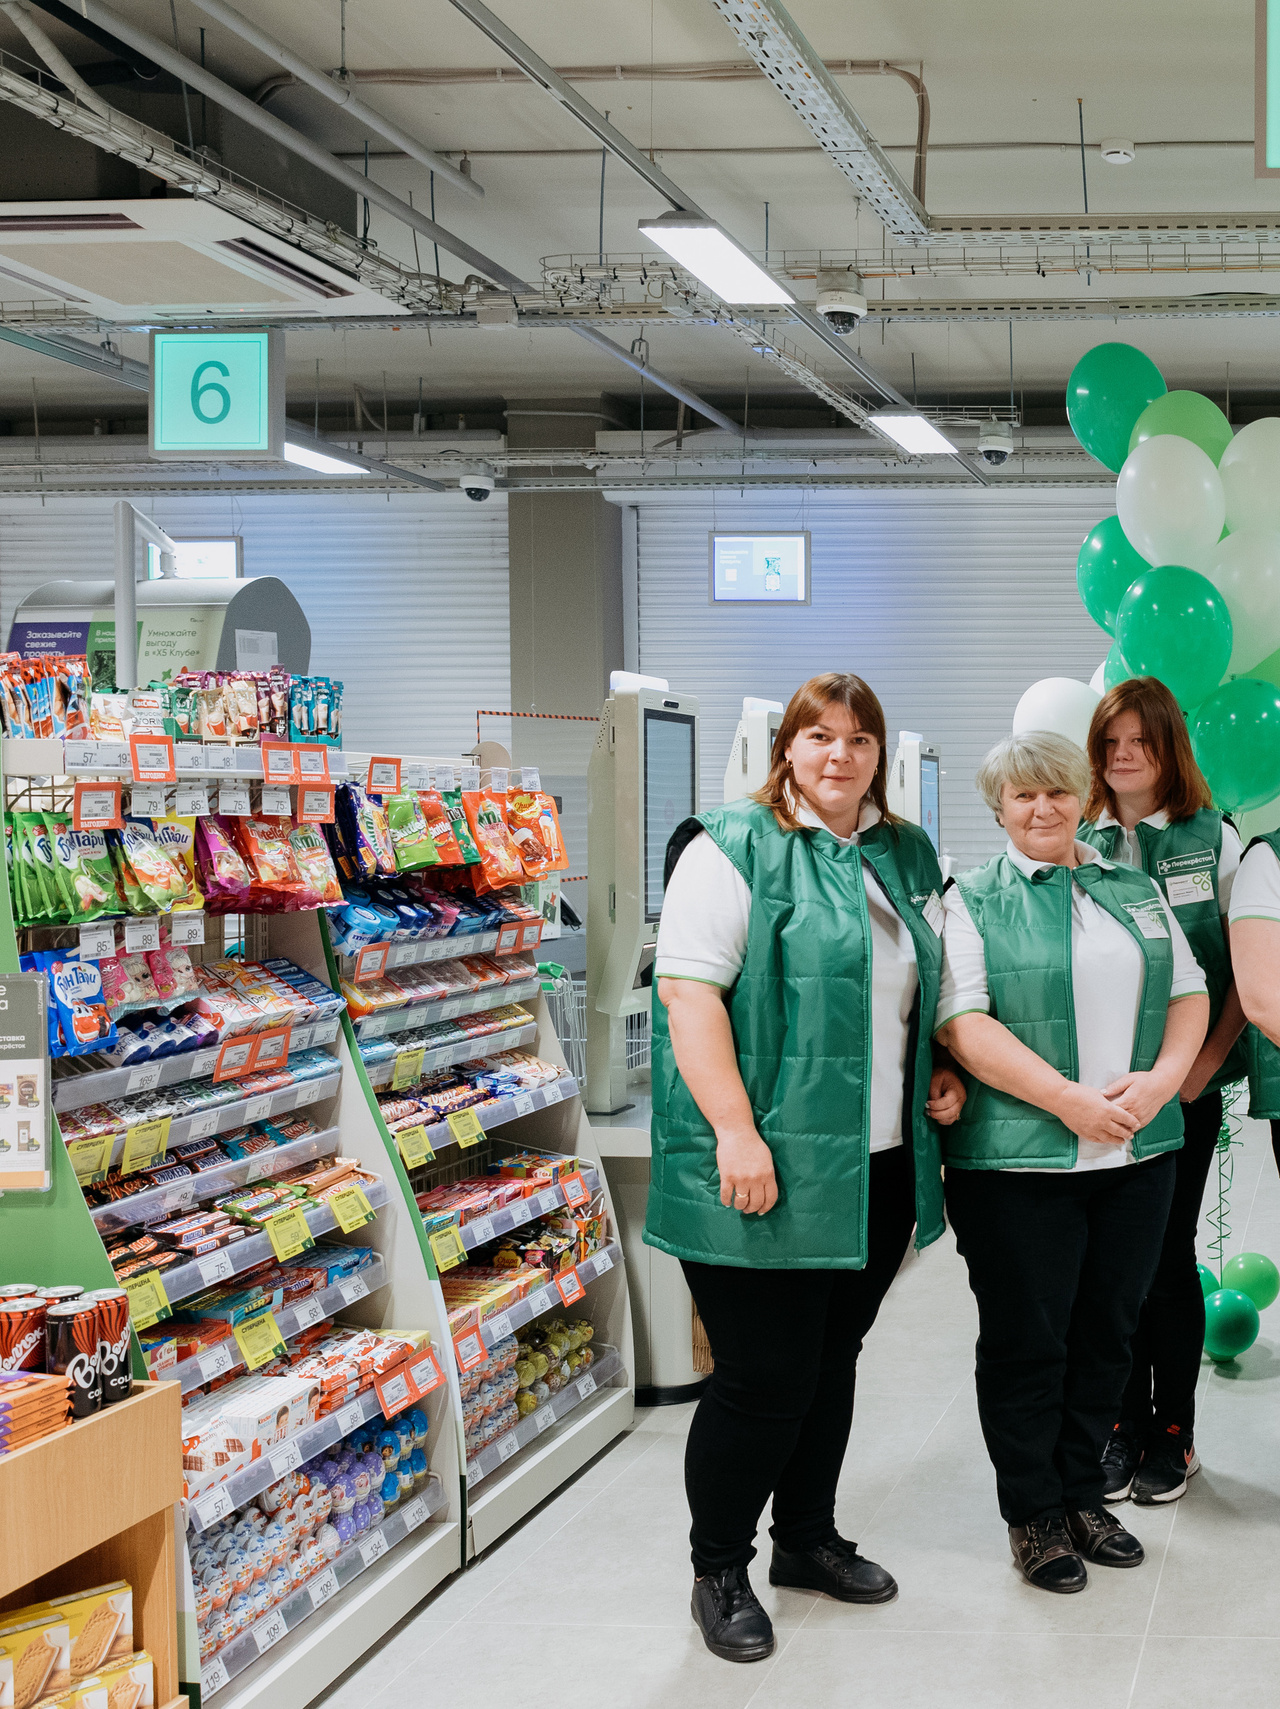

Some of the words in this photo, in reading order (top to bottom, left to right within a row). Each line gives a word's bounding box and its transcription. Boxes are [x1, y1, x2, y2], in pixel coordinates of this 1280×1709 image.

[190, 360, 231, 425] 6
[26, 630, 83, 640] Заказывайте
[147, 629, 198, 638] Умножайте
[25, 640, 57, 649] свежие
[146, 640, 178, 648] выгоду
[1171, 854, 1213, 868] Перекрёсток
[0, 1034, 26, 1042] ставка
[179, 1138, 216, 1157] SNICKERS
[153, 1165, 191, 1184] SNICKERS
[126, 1277, 151, 1292] УПЕРЦЕНА
[88, 1388, 103, 1400] COL
